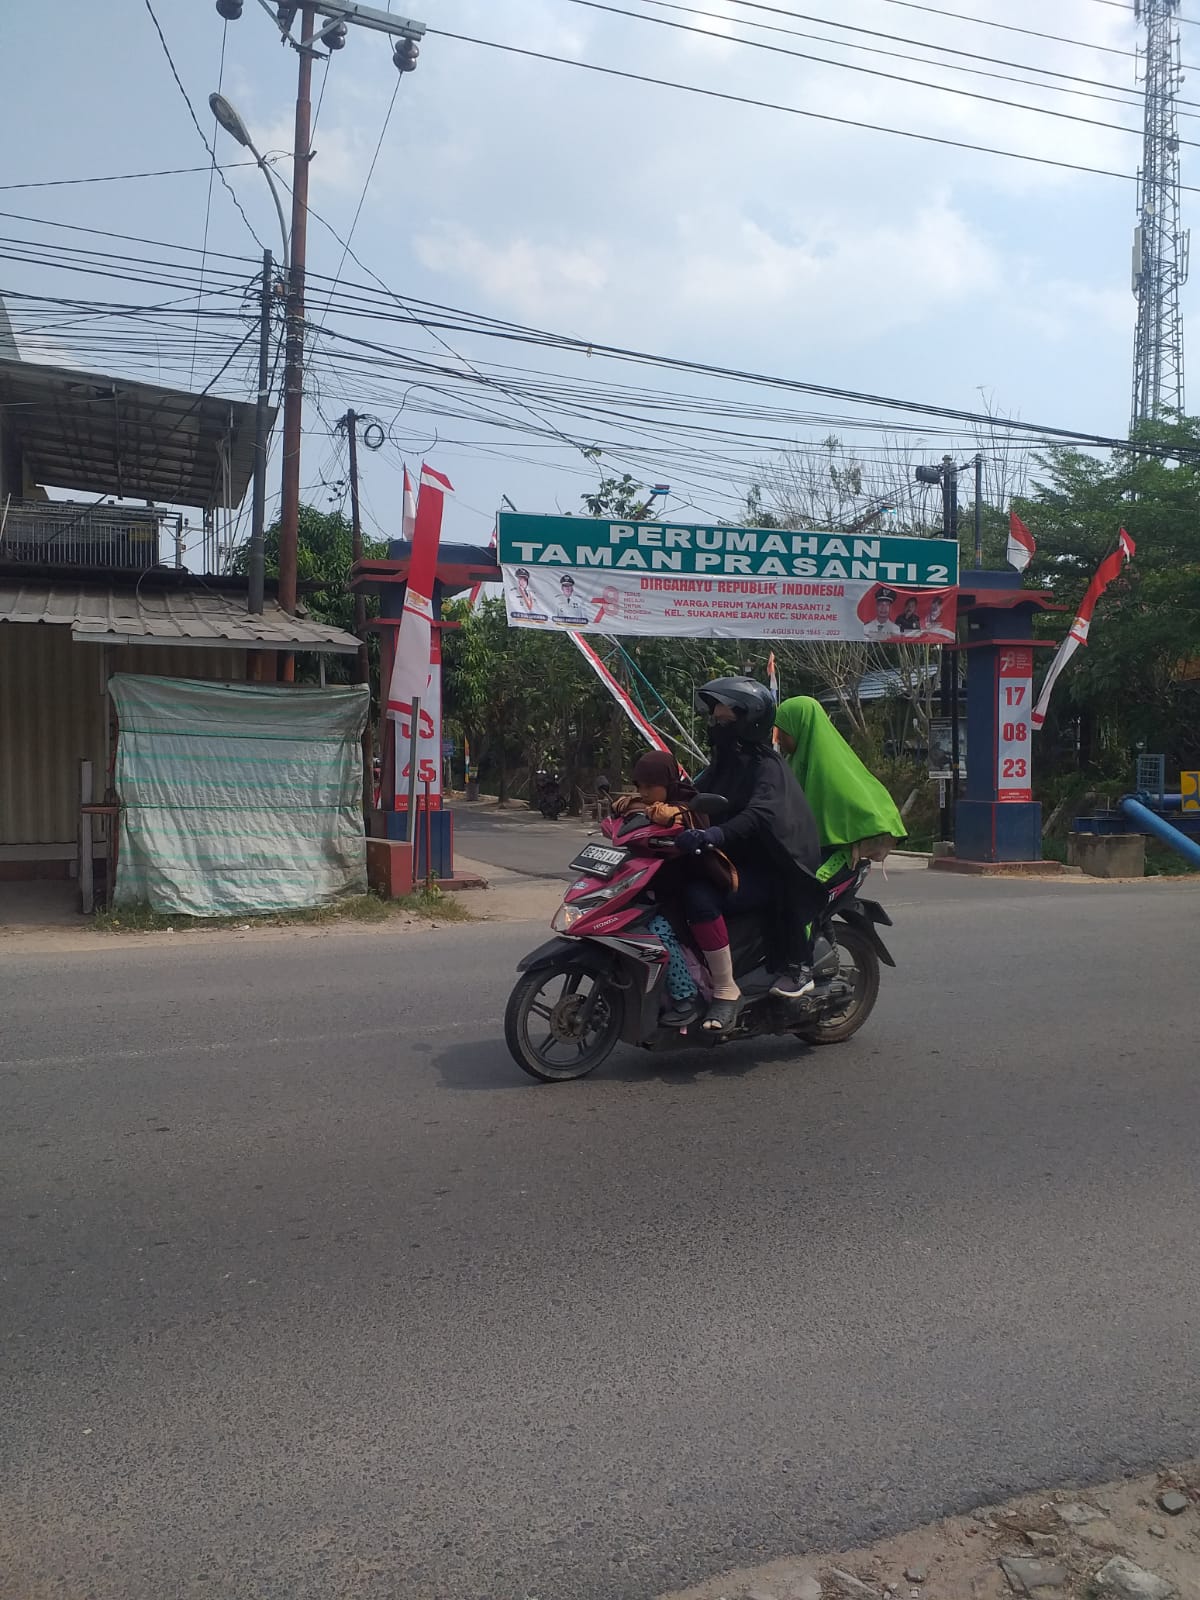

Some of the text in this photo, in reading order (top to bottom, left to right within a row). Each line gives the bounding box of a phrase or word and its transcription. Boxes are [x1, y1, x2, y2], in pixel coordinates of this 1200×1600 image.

[609, 524, 880, 558] PERUMAHAN
[511, 541, 949, 583] TAMAN PRASANTI 2
[640, 577, 845, 597] DIRGAHAYU REPUBLIK INDONESIA
[664, 608, 838, 621] KEL. SUKARAME BARU KEC. SUKARAME
[673, 599, 709, 608] WARGA
[712, 600, 744, 609] PERUM
[746, 601, 778, 610] TAMAN
[781, 603, 824, 611] PRASANTI
[1005, 686, 1026, 706] 17
[1002, 722, 1027, 742] 08
[1002, 758, 1027, 778] 23
[593, 916, 619, 930] HONDA
